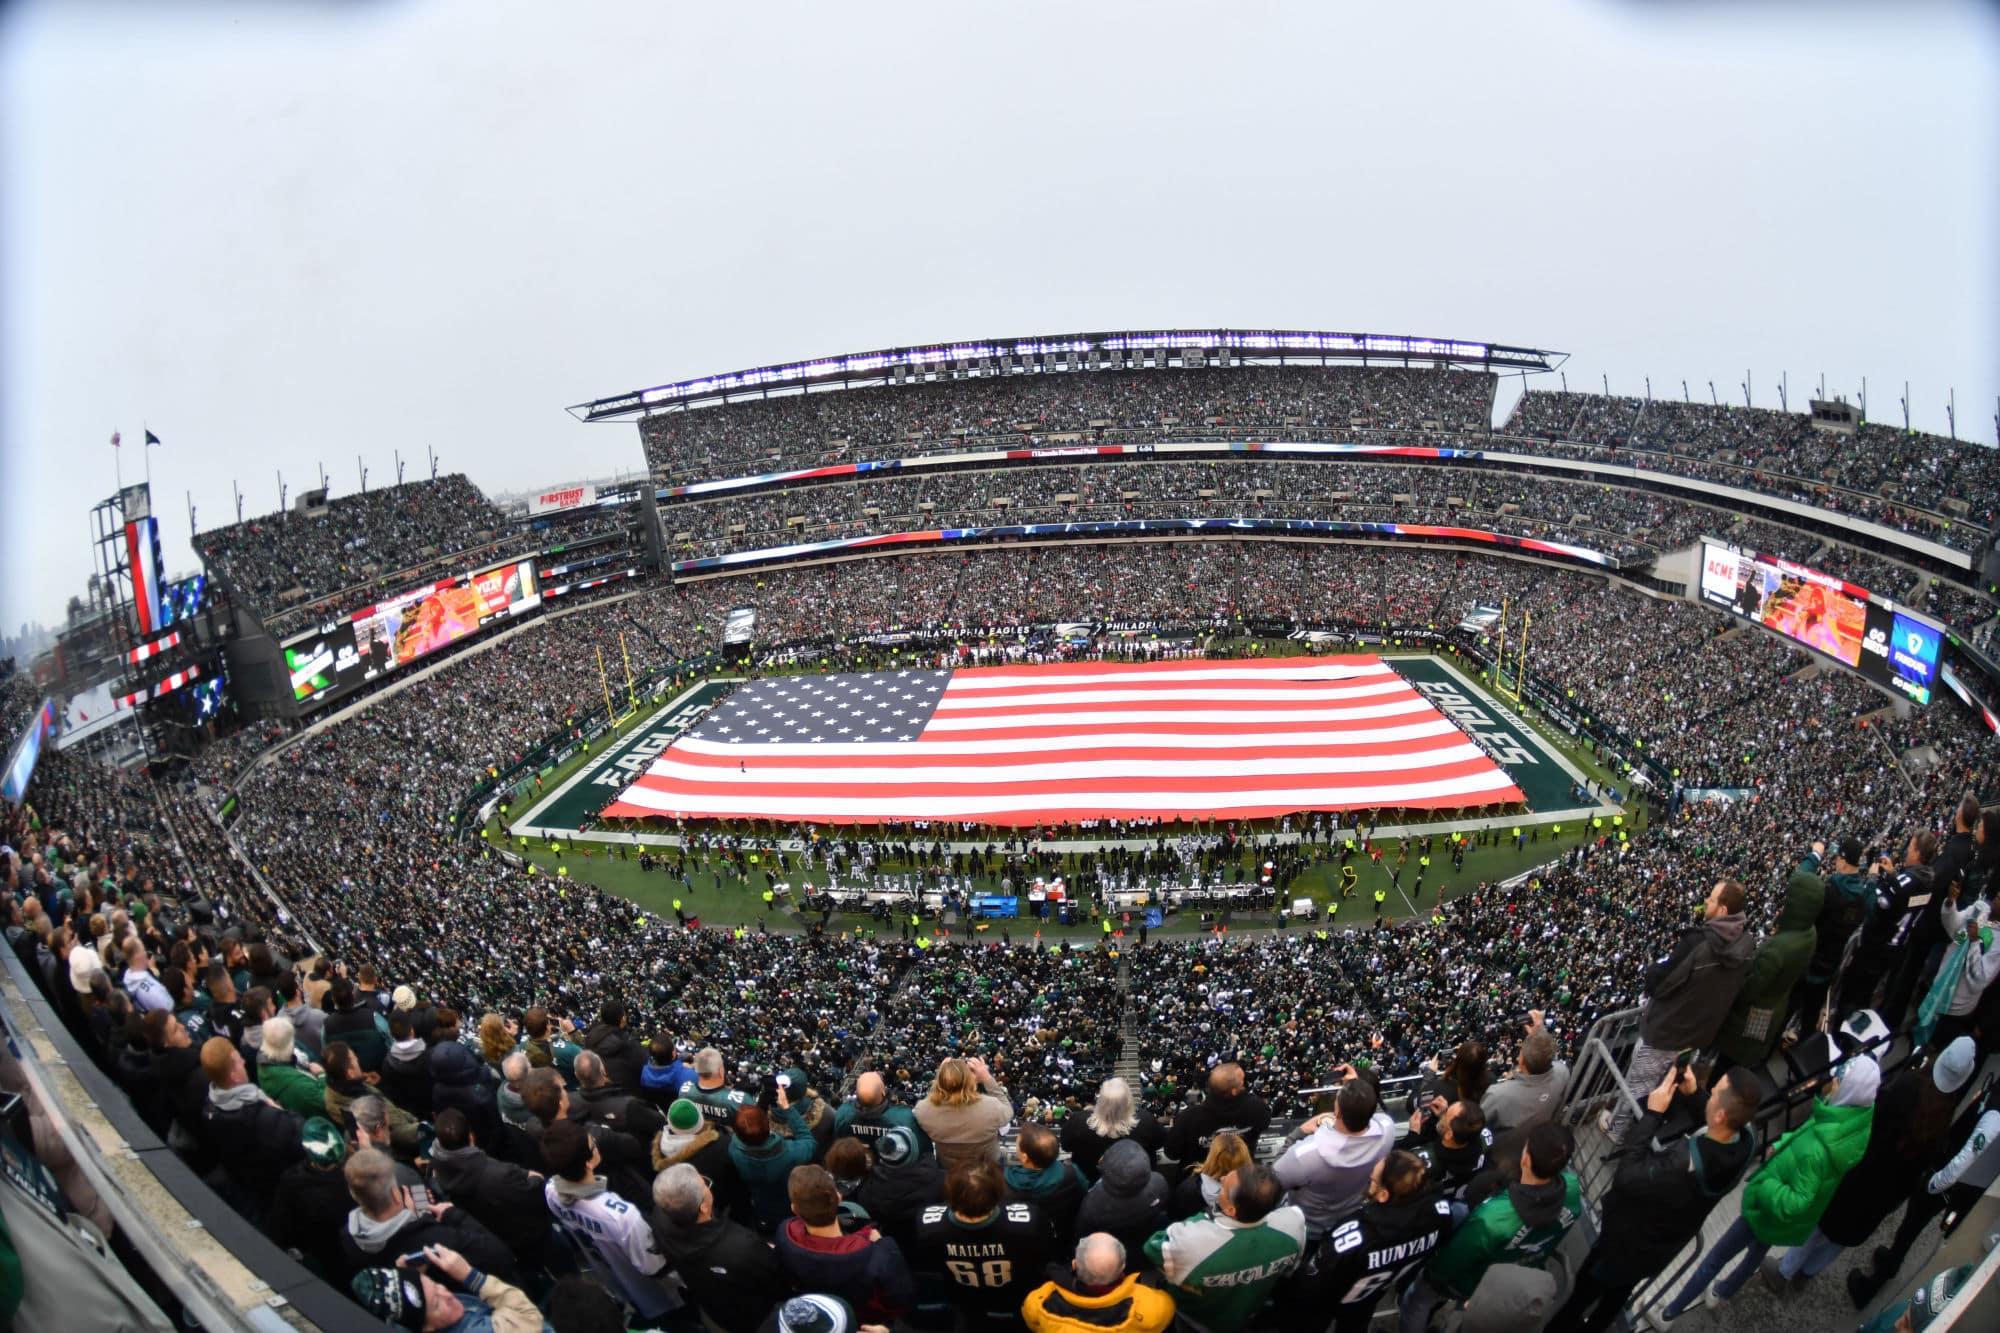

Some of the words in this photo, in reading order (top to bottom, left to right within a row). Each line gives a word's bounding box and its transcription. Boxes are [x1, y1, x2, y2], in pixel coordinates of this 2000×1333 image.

[540, 488, 584, 505] FIRSTRUST
[560, 498, 581, 508] BANK
[1708, 560, 1734, 580] ACME
[989, 626, 1030, 636] EAGLES
[1416, 681, 1540, 765] EAGLES
[1501, 711, 1535, 735] RACISM
[590, 704, 713, 787] EAGLES
[850, 1124, 891, 1137] TROTTE
[604, 1199, 629, 1214] 5
[1331, 1220, 1363, 1254] 69
[946, 1243, 1005, 1257] MAILATA
[1367, 1229, 1440, 1270] RUNYAN
[946, 1260, 1013, 1288] 68
